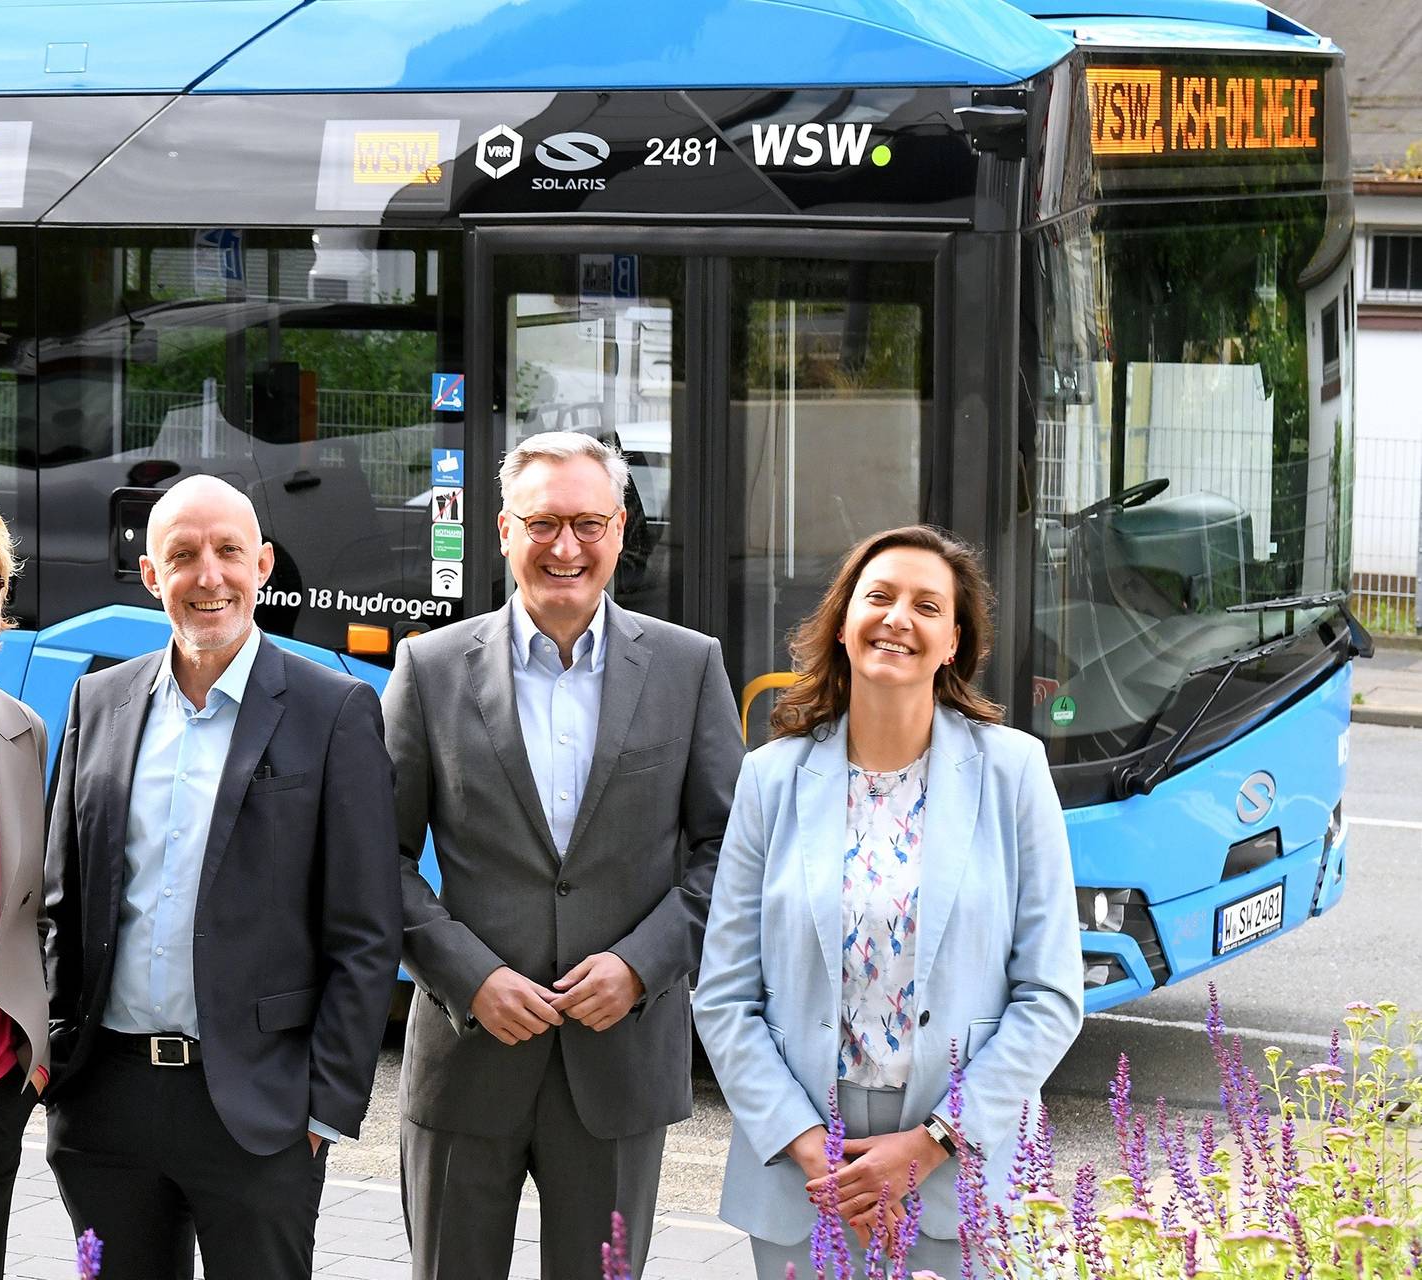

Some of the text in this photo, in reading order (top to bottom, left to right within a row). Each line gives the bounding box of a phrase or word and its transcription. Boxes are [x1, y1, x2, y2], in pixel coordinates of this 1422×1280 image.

[486, 145, 512, 158] VRR
[643, 137, 718, 167] 2481
[531, 178, 606, 190] SOLARIS
[308, 588, 333, 609] 18
[336, 590, 452, 620] hydrogen
[1060, 697, 1068, 711] 4
[1255, 892, 1280, 927] 2481
